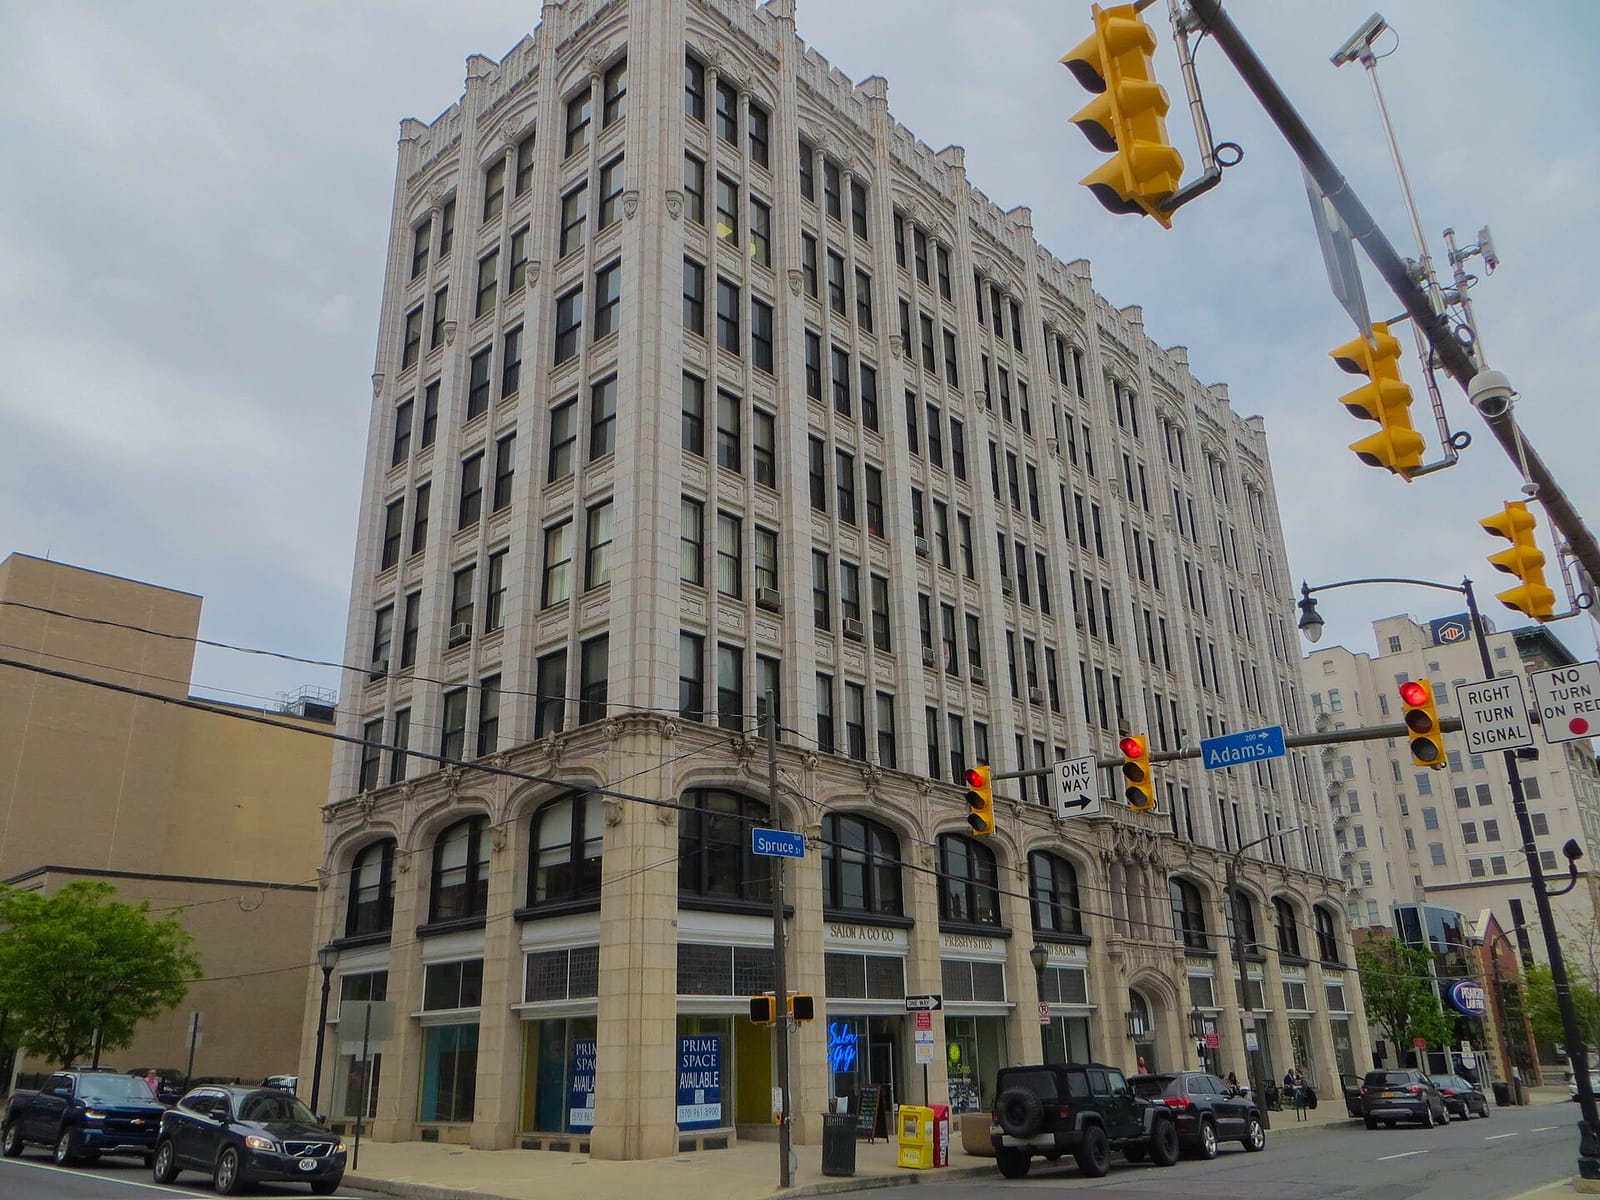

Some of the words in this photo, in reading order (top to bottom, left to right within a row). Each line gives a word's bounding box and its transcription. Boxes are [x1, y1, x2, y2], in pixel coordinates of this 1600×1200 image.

[1551, 669, 1580, 686] NO
[1468, 685, 1510, 704] RIGHT
[1549, 684, 1592, 702] TURN
[1474, 705, 1514, 724] TURN
[1544, 704, 1566, 719] ON
[1472, 725, 1527, 746] SIGNAL
[1210, 743, 1265, 765] Adams
[1062, 761, 1089, 778] ONE
[1062, 776, 1090, 793] WAY
[758, 837, 794, 854] Spruce
[830, 925, 856, 940] SALON
[858, 927, 866, 939] A
[576, 1043, 597, 1056] PRIM
[683, 1039, 718, 1052] PRIME
[576, 1057, 596, 1071] SPA
[683, 1054, 717, 1067] SPACE
[573, 1075, 595, 1092] AVAILA
[679, 1071, 719, 1089] AVAILABLE
